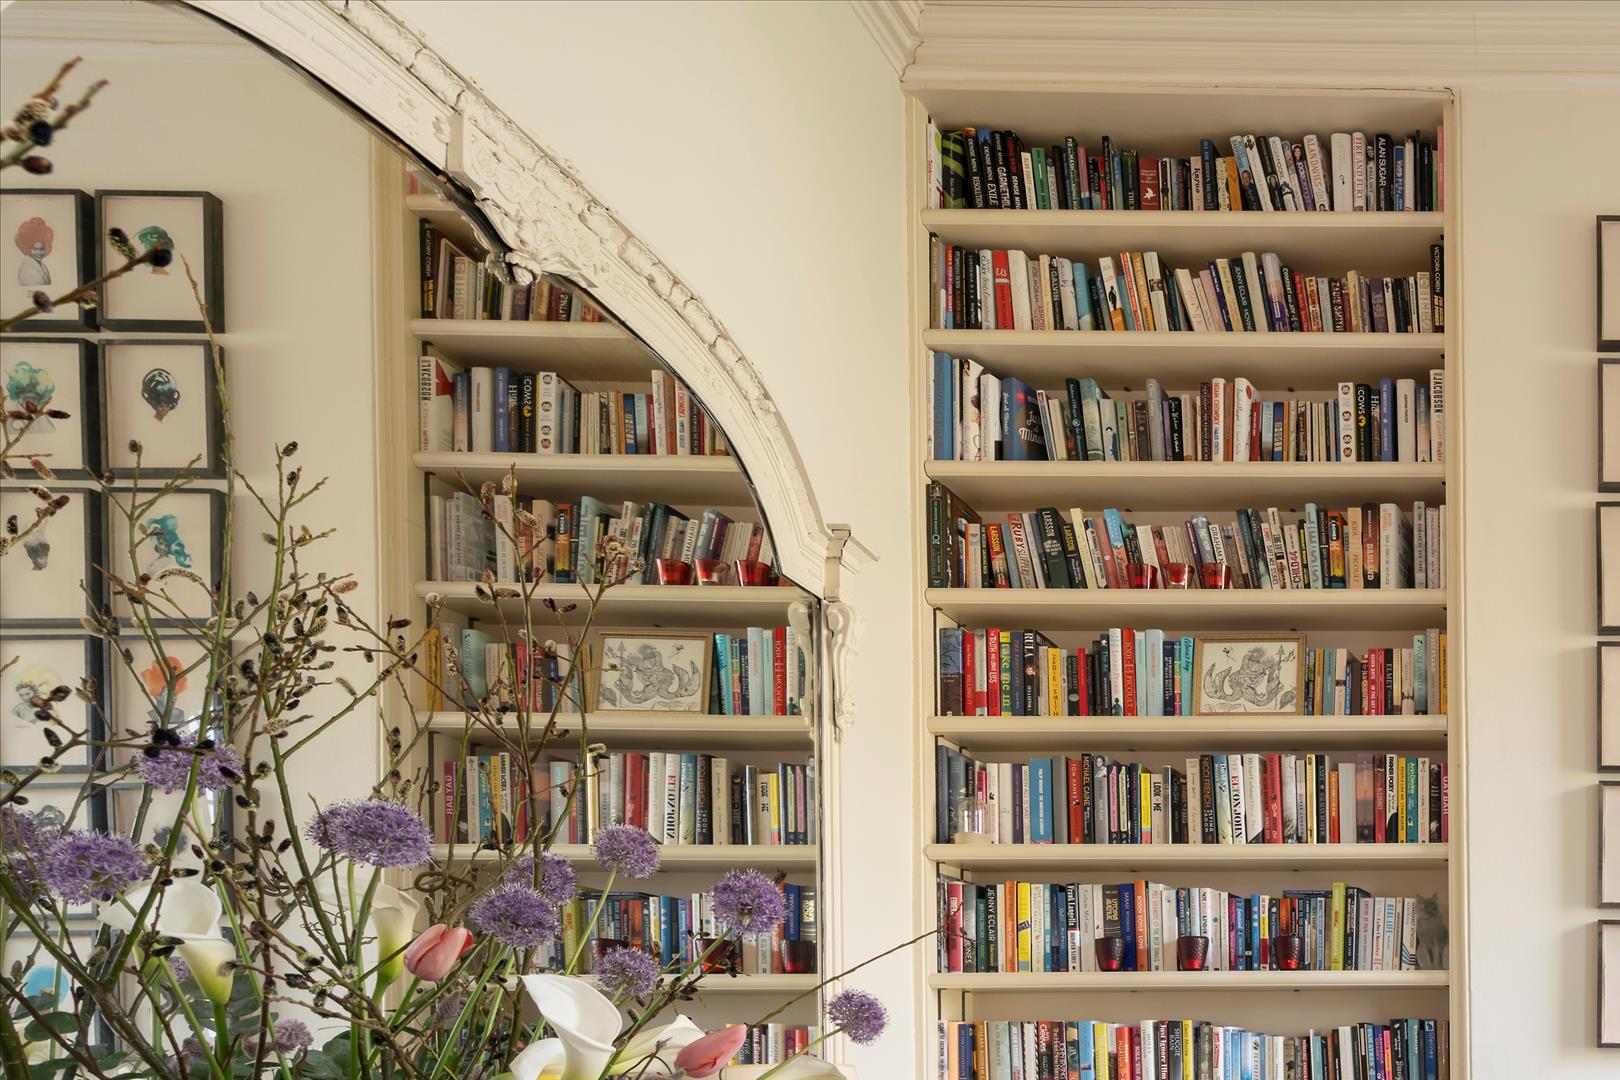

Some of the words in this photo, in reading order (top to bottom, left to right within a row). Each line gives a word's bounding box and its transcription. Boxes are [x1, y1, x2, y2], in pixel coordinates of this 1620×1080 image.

[1305, 138, 1316, 161] ALAN
[1309, 161, 1320, 187] DAVIES
[972, 176, 982, 208] RESOLUTION
[987, 183, 996, 205] EXILE
[1283, 268, 1291, 294] COMFORT
[1238, 285, 1247, 305] ECLAIR
[1358, 389, 1366, 414] COWS
[1371, 396, 1380, 416] Hide
[1433, 377, 1443, 414] JACOBSON
[1011, 522, 1024, 548] RUBY
[1042, 511, 1053, 537] LARSSON
[990, 526, 1000, 552] LARSSON
[1063, 526, 1074, 551] LARSSON
[1209, 526, 1223, 558] GRAHAM
[1024, 633, 1034, 657] RULA
[1126, 676, 1134, 708] PICOULT
[1204, 779, 1212, 807] FRENCH
[1231, 776, 1239, 806] ELTON
[1233, 809, 1243, 838] JOHN
[1067, 901, 1075, 926] Langella
[1039, 1024, 1047, 1053] Cleeves
